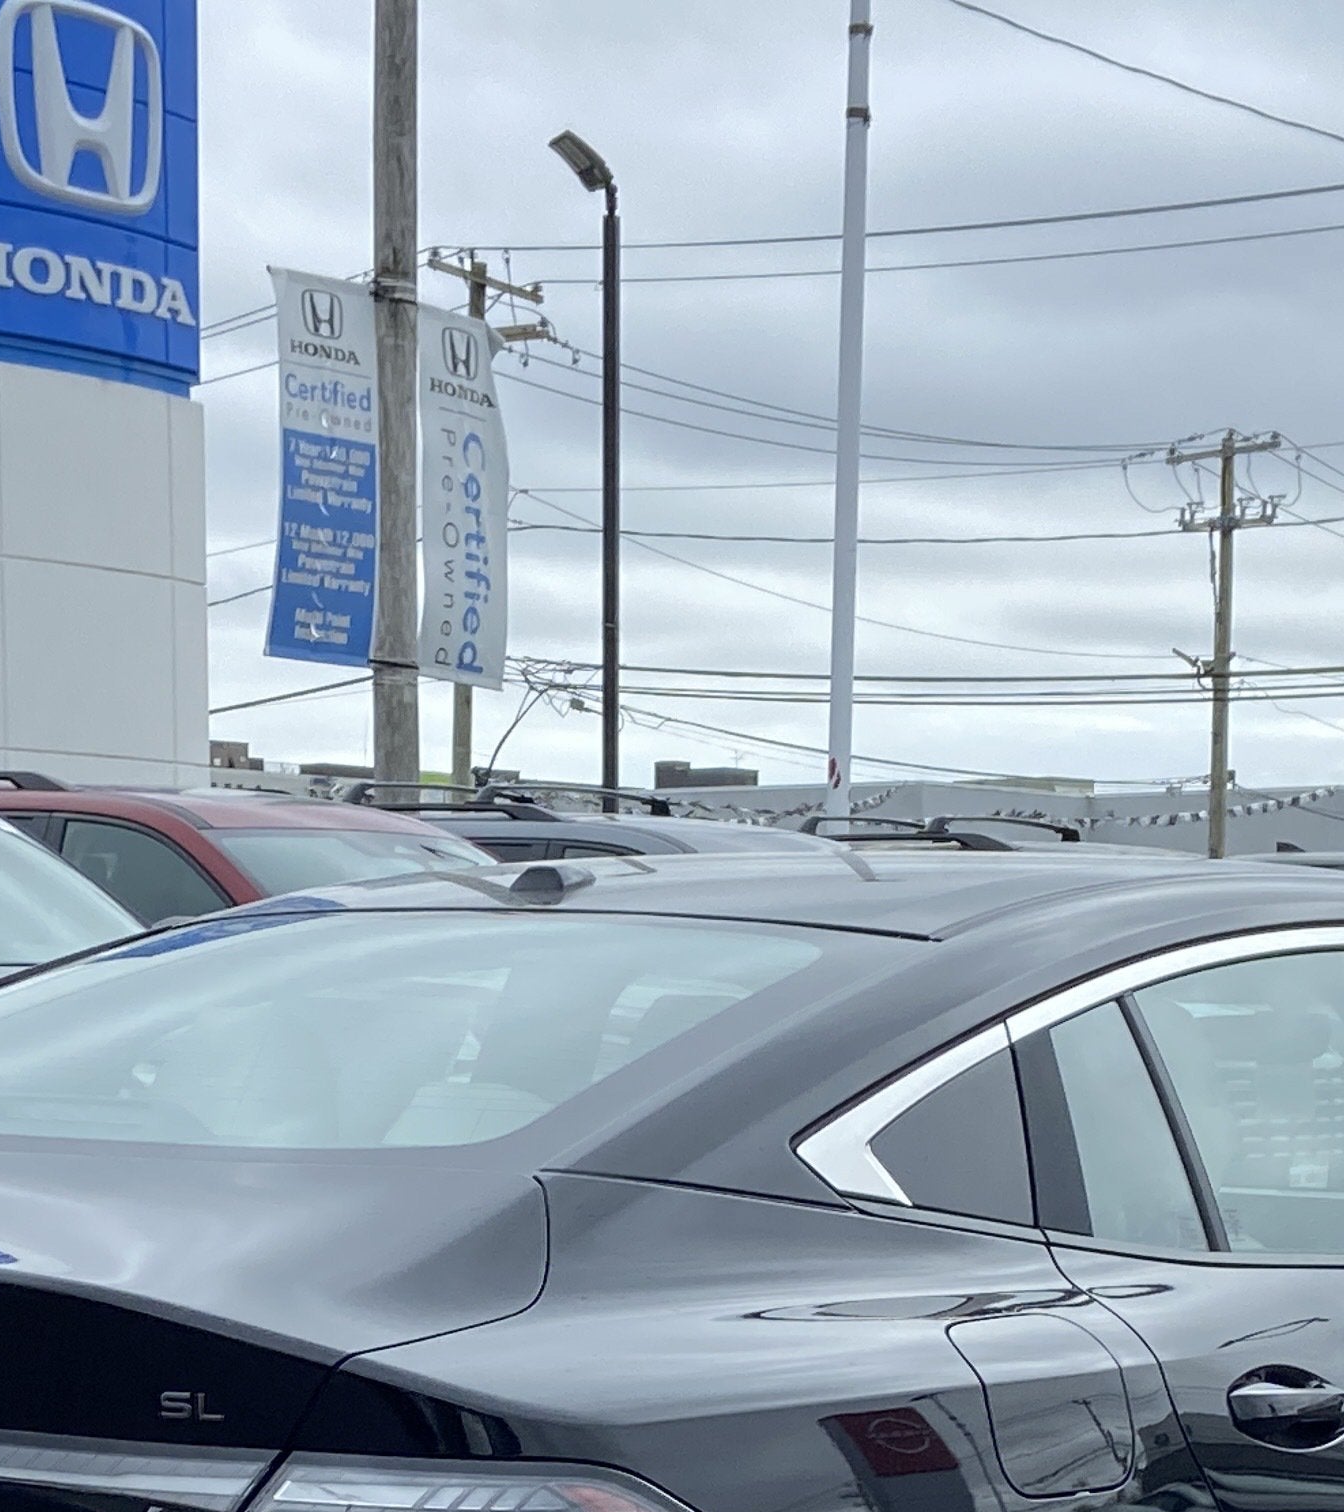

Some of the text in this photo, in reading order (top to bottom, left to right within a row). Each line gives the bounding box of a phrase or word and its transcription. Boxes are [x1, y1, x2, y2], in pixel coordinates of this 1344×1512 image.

[289, 339, 360, 367] HONDA
[284, 372, 373, 412] Certified
[430, 376, 497, 409] HONDA
[435, 427, 460, 667] Pre-Owned
[457, 432, 491, 674] Certified
[159, 1391, 225, 1422] SL
